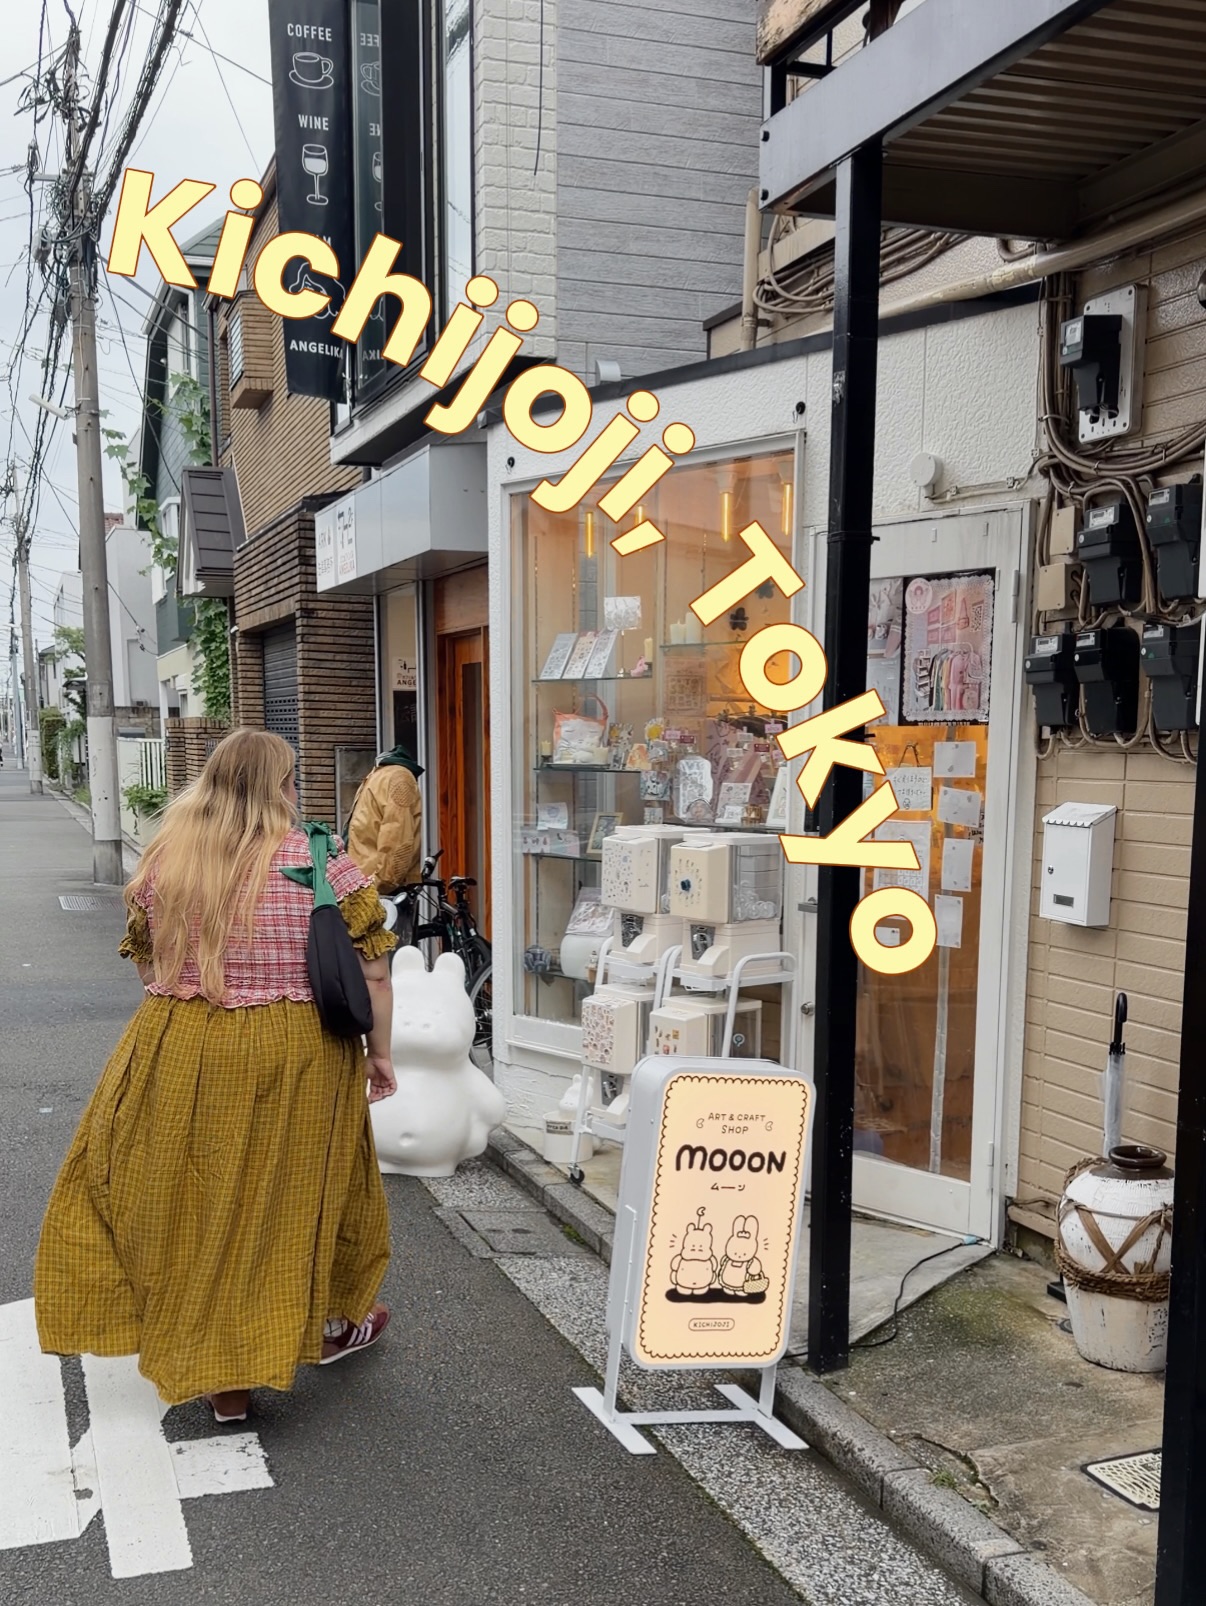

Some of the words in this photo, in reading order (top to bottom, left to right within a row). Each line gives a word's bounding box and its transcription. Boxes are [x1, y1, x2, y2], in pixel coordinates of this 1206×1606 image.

[287, 23, 332, 42] COFFEE
[298, 114, 329, 131] WINE
[290, 339, 344, 359] ANGELIKA
[708, 1112, 727, 1121] ART
[728, 1113, 735, 1121] &
[737, 1114, 766, 1122] CRAFT
[721, 1124, 749, 1134] SHOP
[710, 1182, 746, 1192] ムーン
